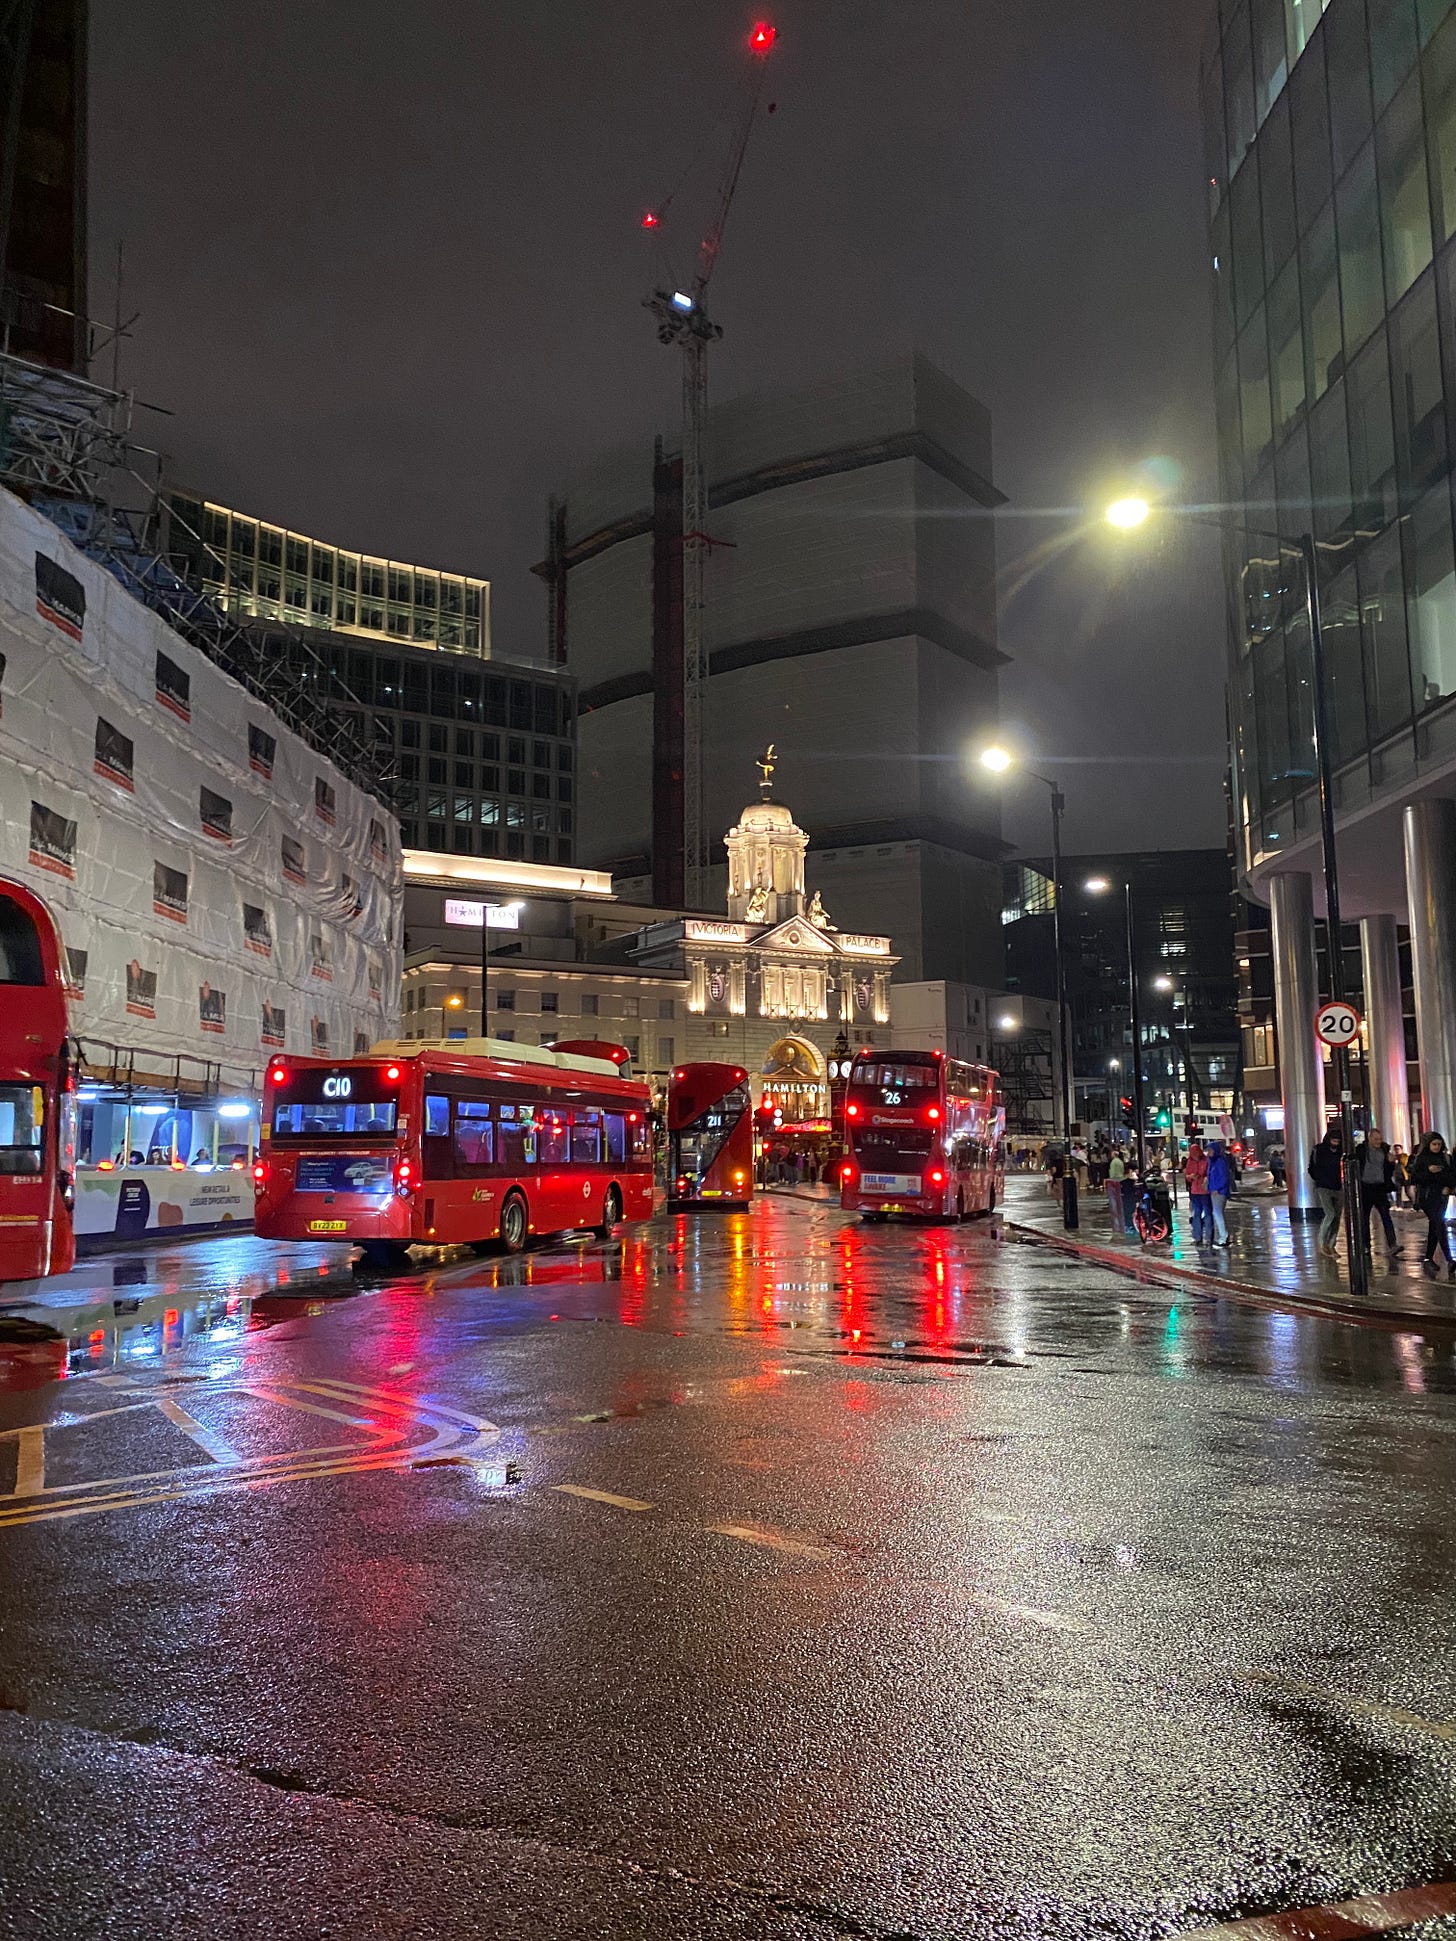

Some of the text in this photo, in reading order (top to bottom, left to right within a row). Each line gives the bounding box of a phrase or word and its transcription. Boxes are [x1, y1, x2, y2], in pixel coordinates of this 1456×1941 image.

[697, 923, 880, 949] VICTORIA PALACE
[1322, 1015, 1354, 1033] 20
[323, 1077, 351, 1097] C10
[763, 1082, 826, 1094] HAMILTON
[885, 1092, 901, 1105] 26
[707, 1115, 722, 1127] 211
